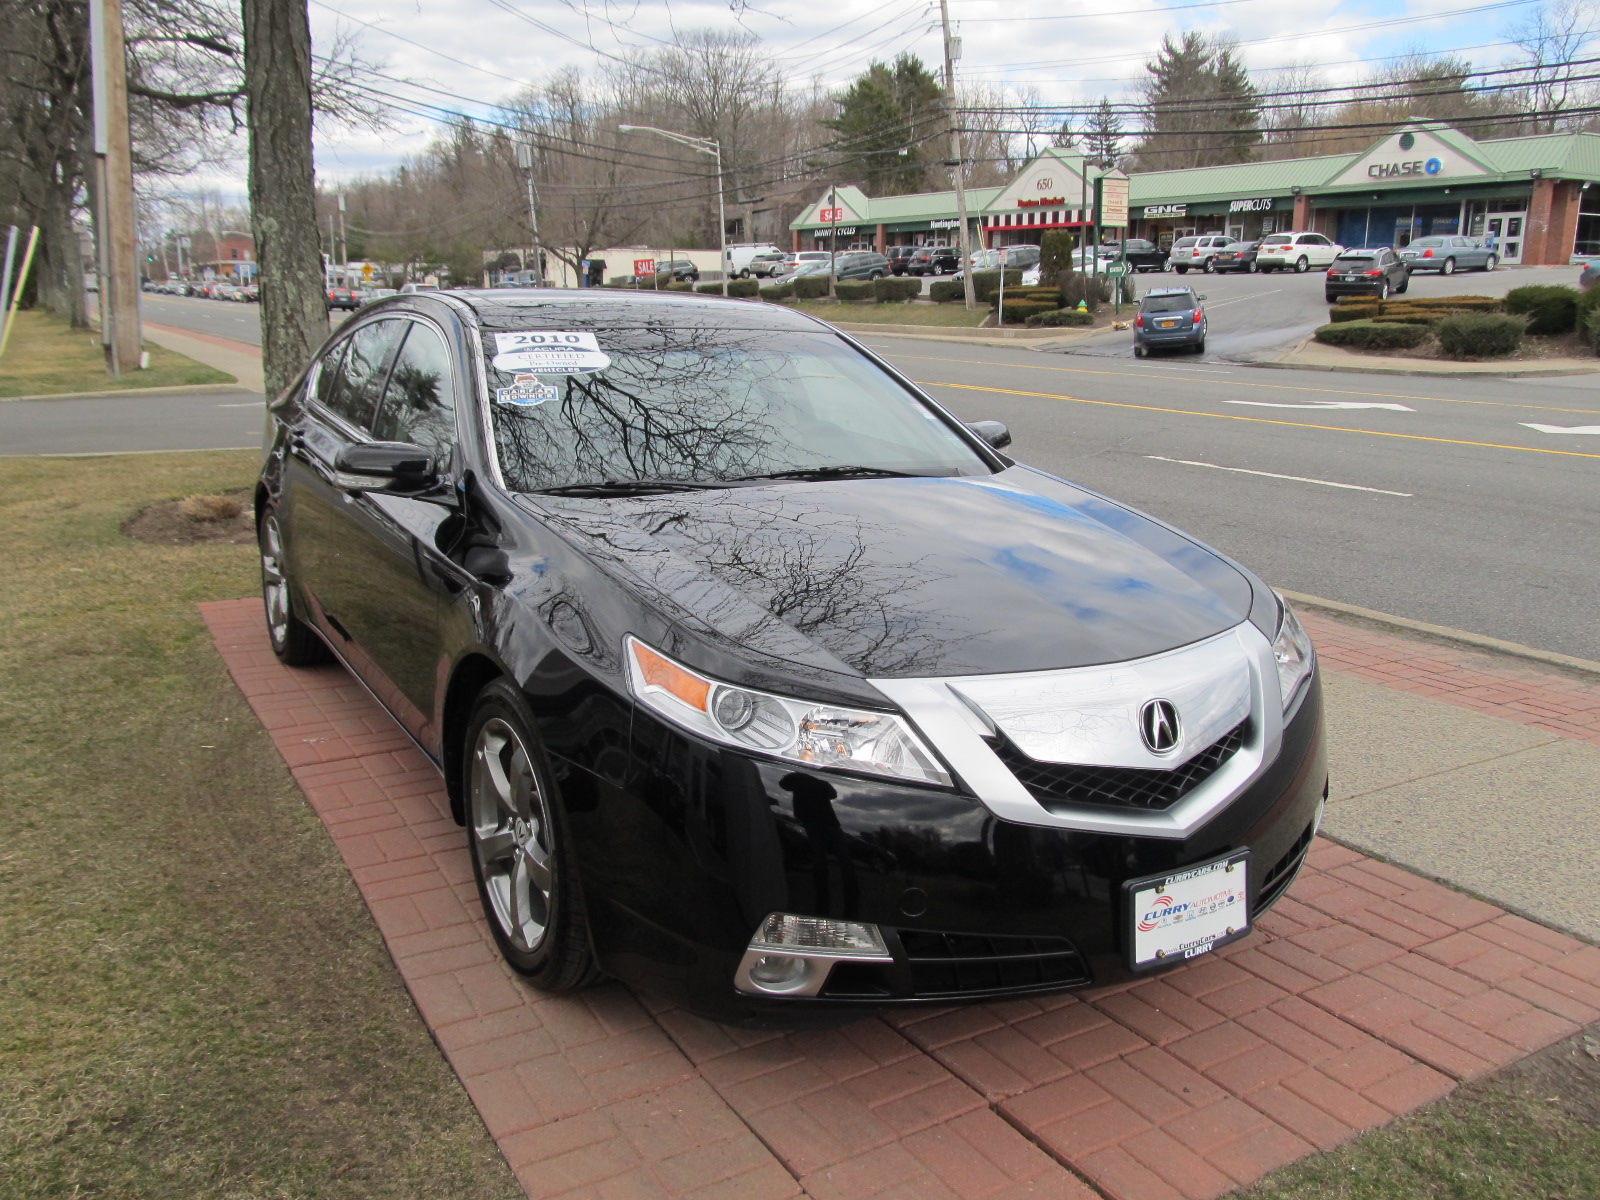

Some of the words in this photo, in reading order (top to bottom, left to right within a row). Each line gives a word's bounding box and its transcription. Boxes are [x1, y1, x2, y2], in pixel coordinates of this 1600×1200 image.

[1368, 161, 1425, 178] CHASE
[1036, 178, 1053, 191] 650
[1143, 204, 1187, 214] GNC
[1229, 198, 1272, 212] SUPERCUTS
[814, 228, 837, 238] DANNYS
[837, 227, 856, 236] CYCLES
[638, 260, 655, 274] SALE
[514, 335, 580, 345] 2010
[1165, 860, 1229, 885] CURRYCARS.COM
[1143, 902, 1191, 922] CURRY
[1190, 888, 1234, 909] AUTOMOTIVE
[1184, 941, 1214, 959] CURRY
